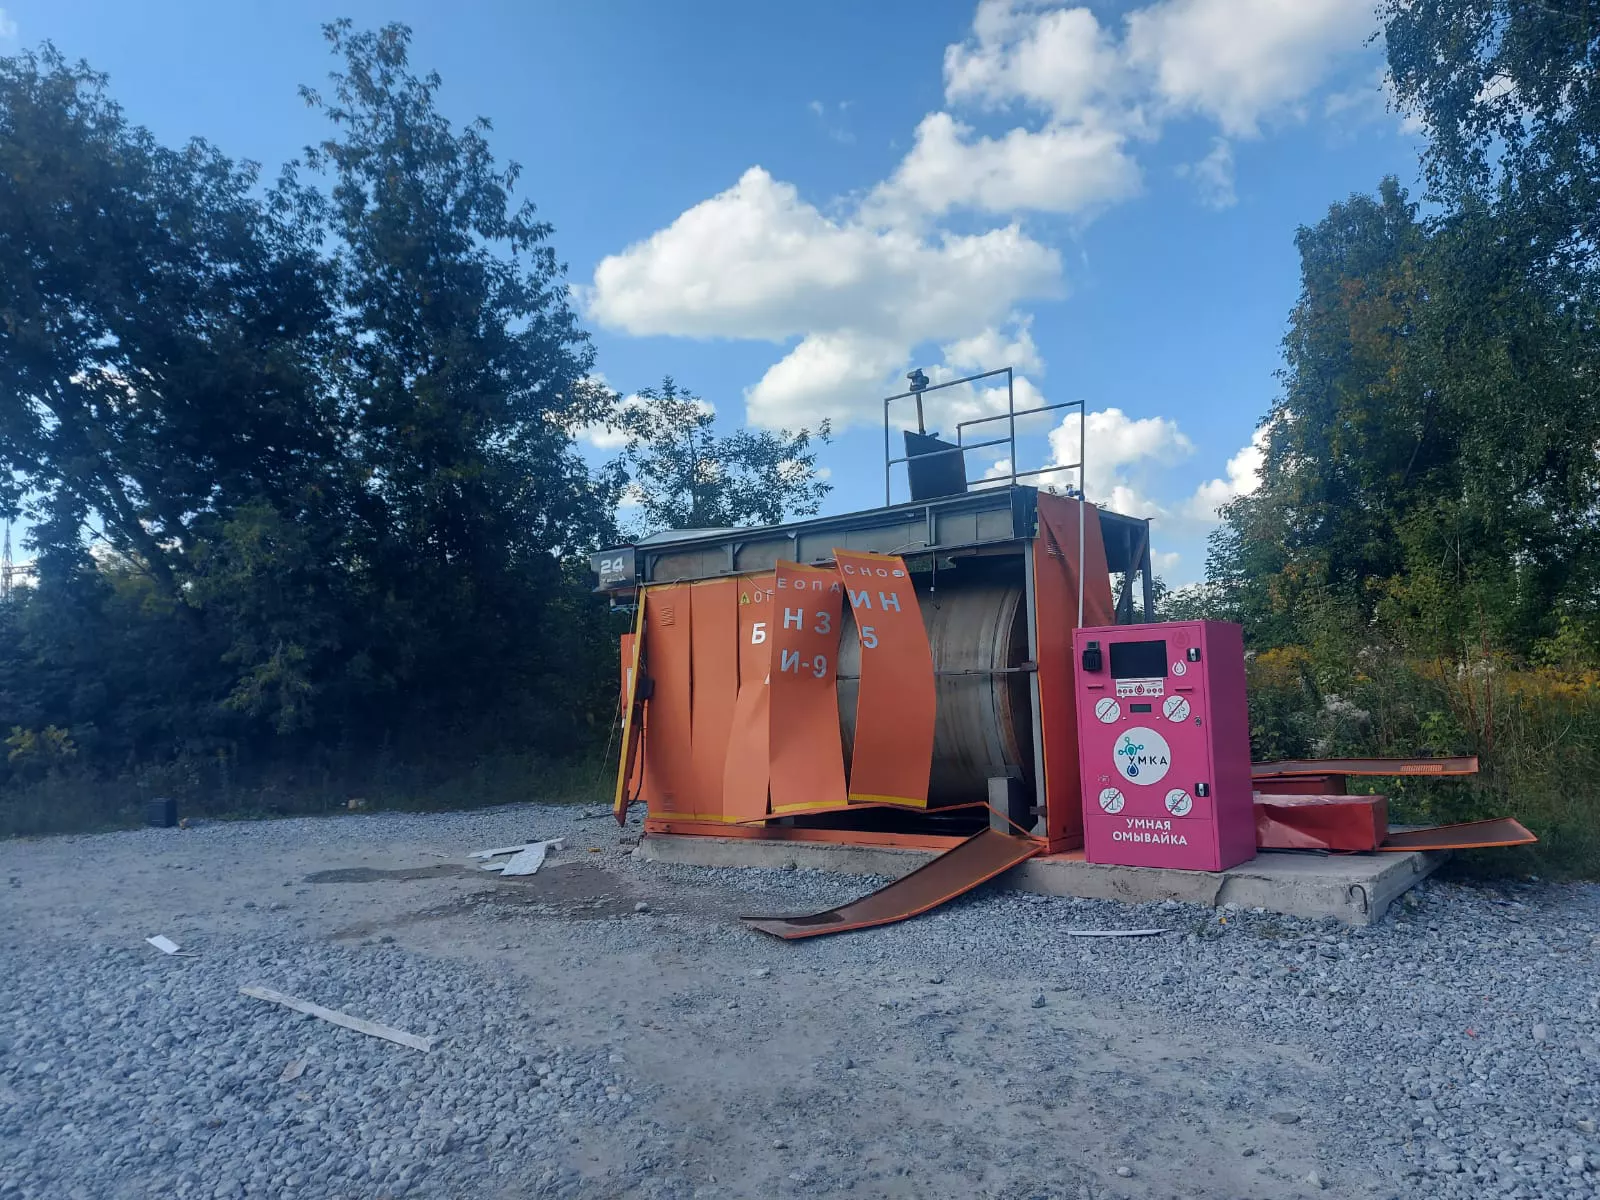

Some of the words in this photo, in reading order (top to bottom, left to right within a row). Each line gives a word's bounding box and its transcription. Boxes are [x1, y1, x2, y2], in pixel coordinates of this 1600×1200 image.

[600, 556, 624, 574] 24
[754, 564, 888, 603] ОГЕОПАСНО
[751, 589, 900, 645] БНЗИН
[1128, 755, 1168, 766] УМКА
[1126, 818, 1171, 831] УМНАЯ
[1112, 830, 1188, 846] ОМЫВАЙКА
